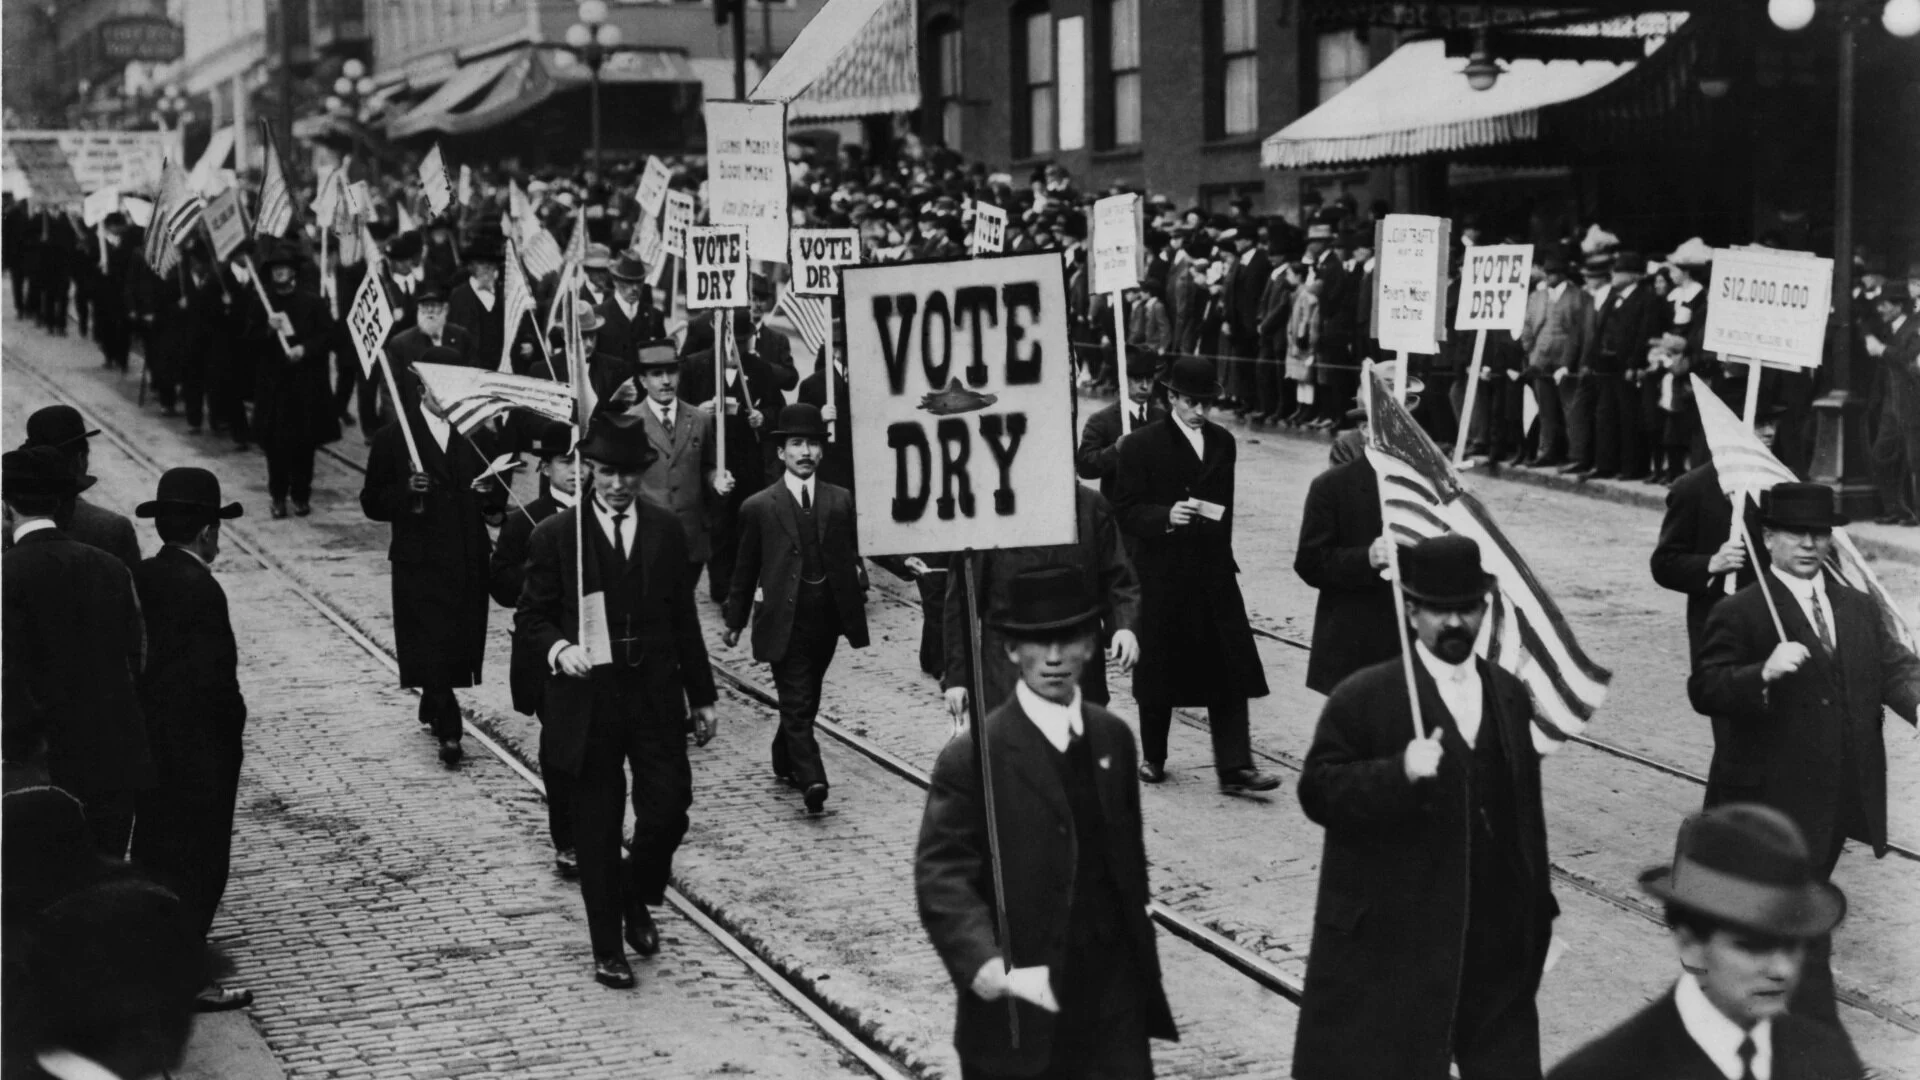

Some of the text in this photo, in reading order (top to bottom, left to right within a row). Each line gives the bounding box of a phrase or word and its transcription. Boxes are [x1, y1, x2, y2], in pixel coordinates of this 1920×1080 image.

[692, 233, 740, 265] VOTE
[800, 237, 853, 261] VOTE
[697, 269, 736, 301] DRY
[1469, 289, 1513, 319] DRY
[871, 281, 1042, 396] VOTE
[886, 411, 1028, 524] DRY
